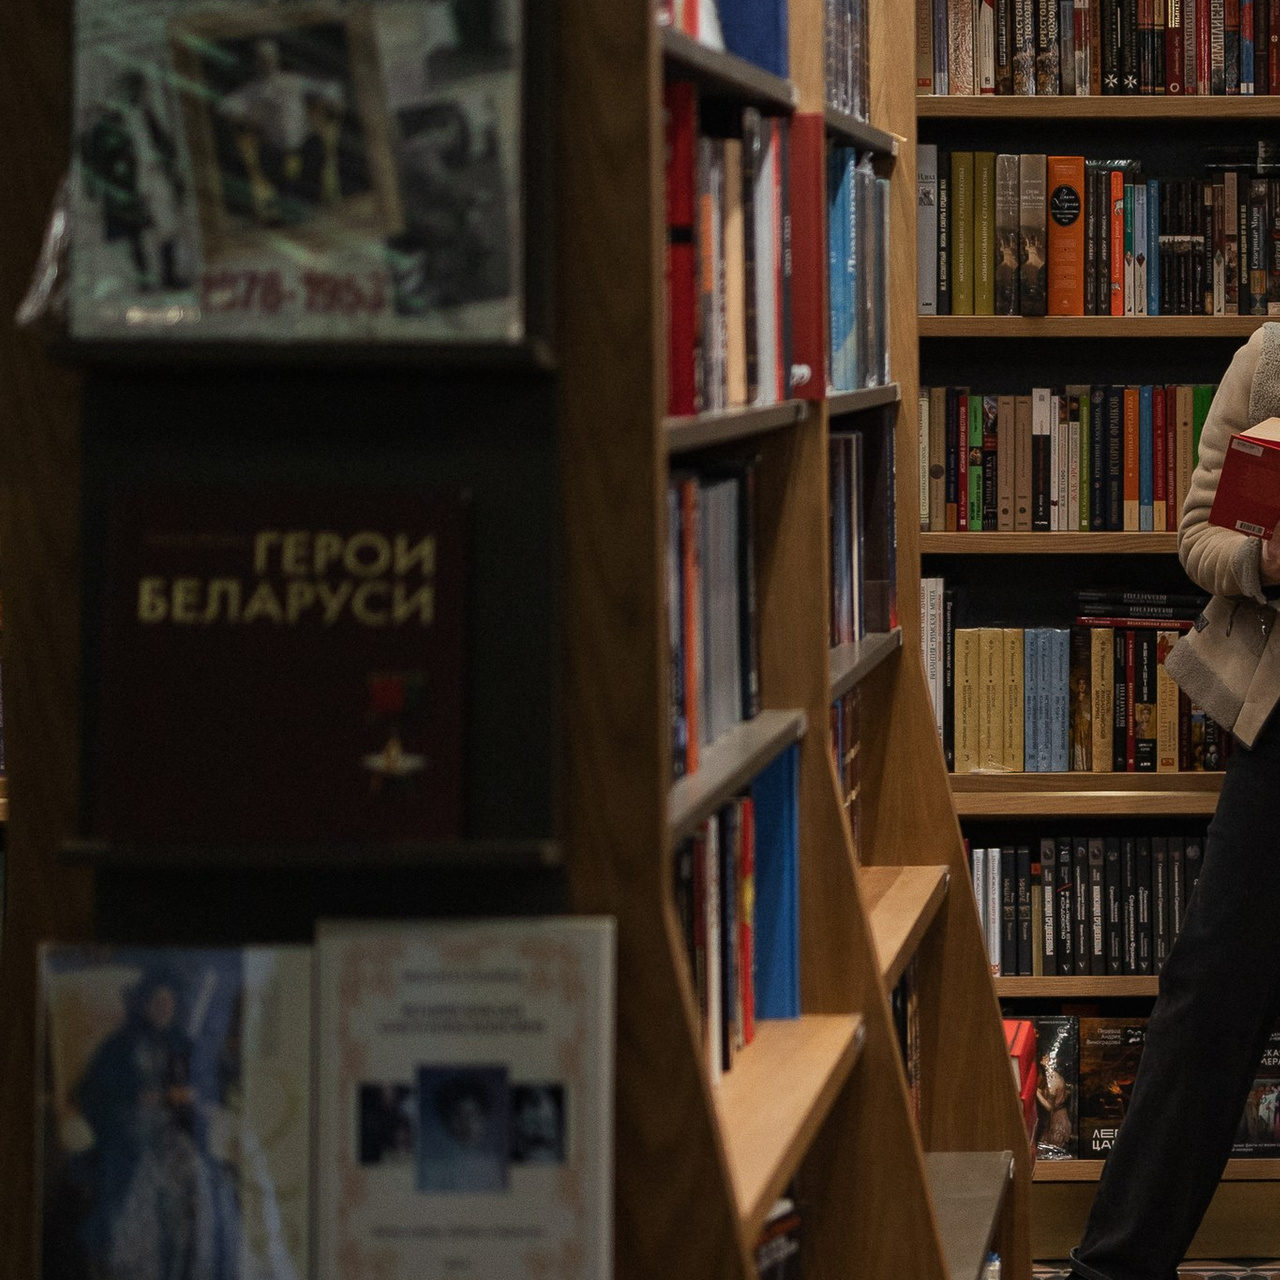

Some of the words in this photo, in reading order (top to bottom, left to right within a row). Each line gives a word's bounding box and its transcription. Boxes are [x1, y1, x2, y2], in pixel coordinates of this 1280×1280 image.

[1109, 396, 1119, 435] ФРАНКОВ
[1109, 437, 1119, 475] ИСТОРИЯ
[254, 531, 435, 577] ГЕРОИ
[138, 577, 435, 628] БЕЛАРУСИ
